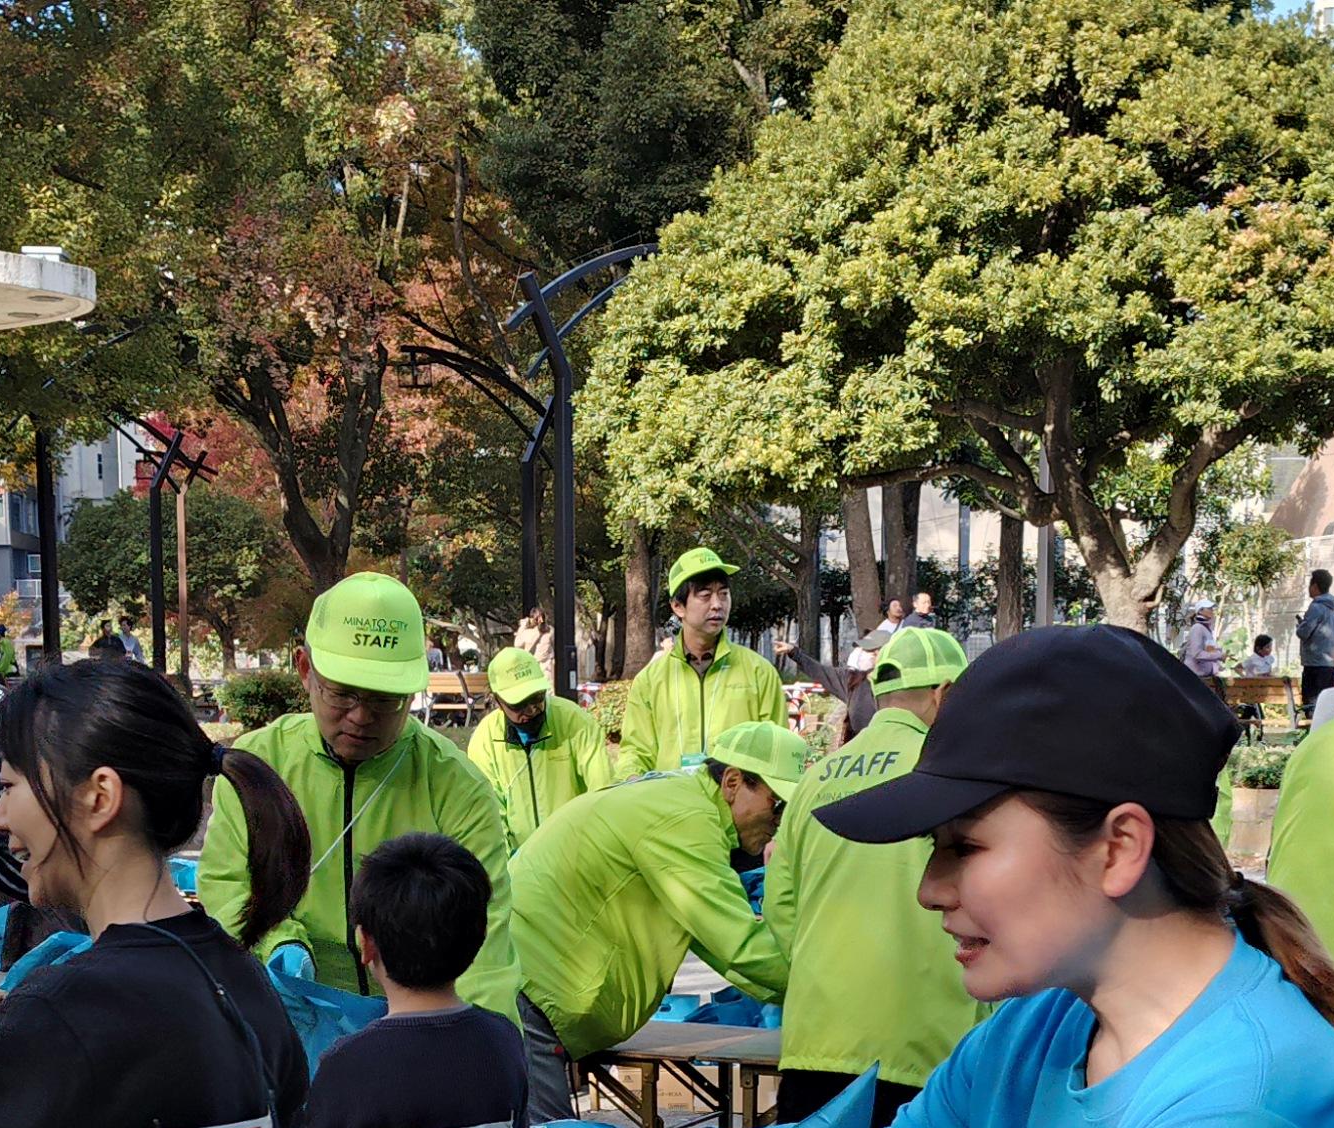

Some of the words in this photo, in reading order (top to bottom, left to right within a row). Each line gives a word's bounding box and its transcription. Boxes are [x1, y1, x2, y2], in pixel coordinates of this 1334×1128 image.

[342, 616, 387, 628] MINATO
[389, 619, 409, 631] CITY
[352, 632, 399, 649] STAFF
[819, 751, 900, 782] STAFF
